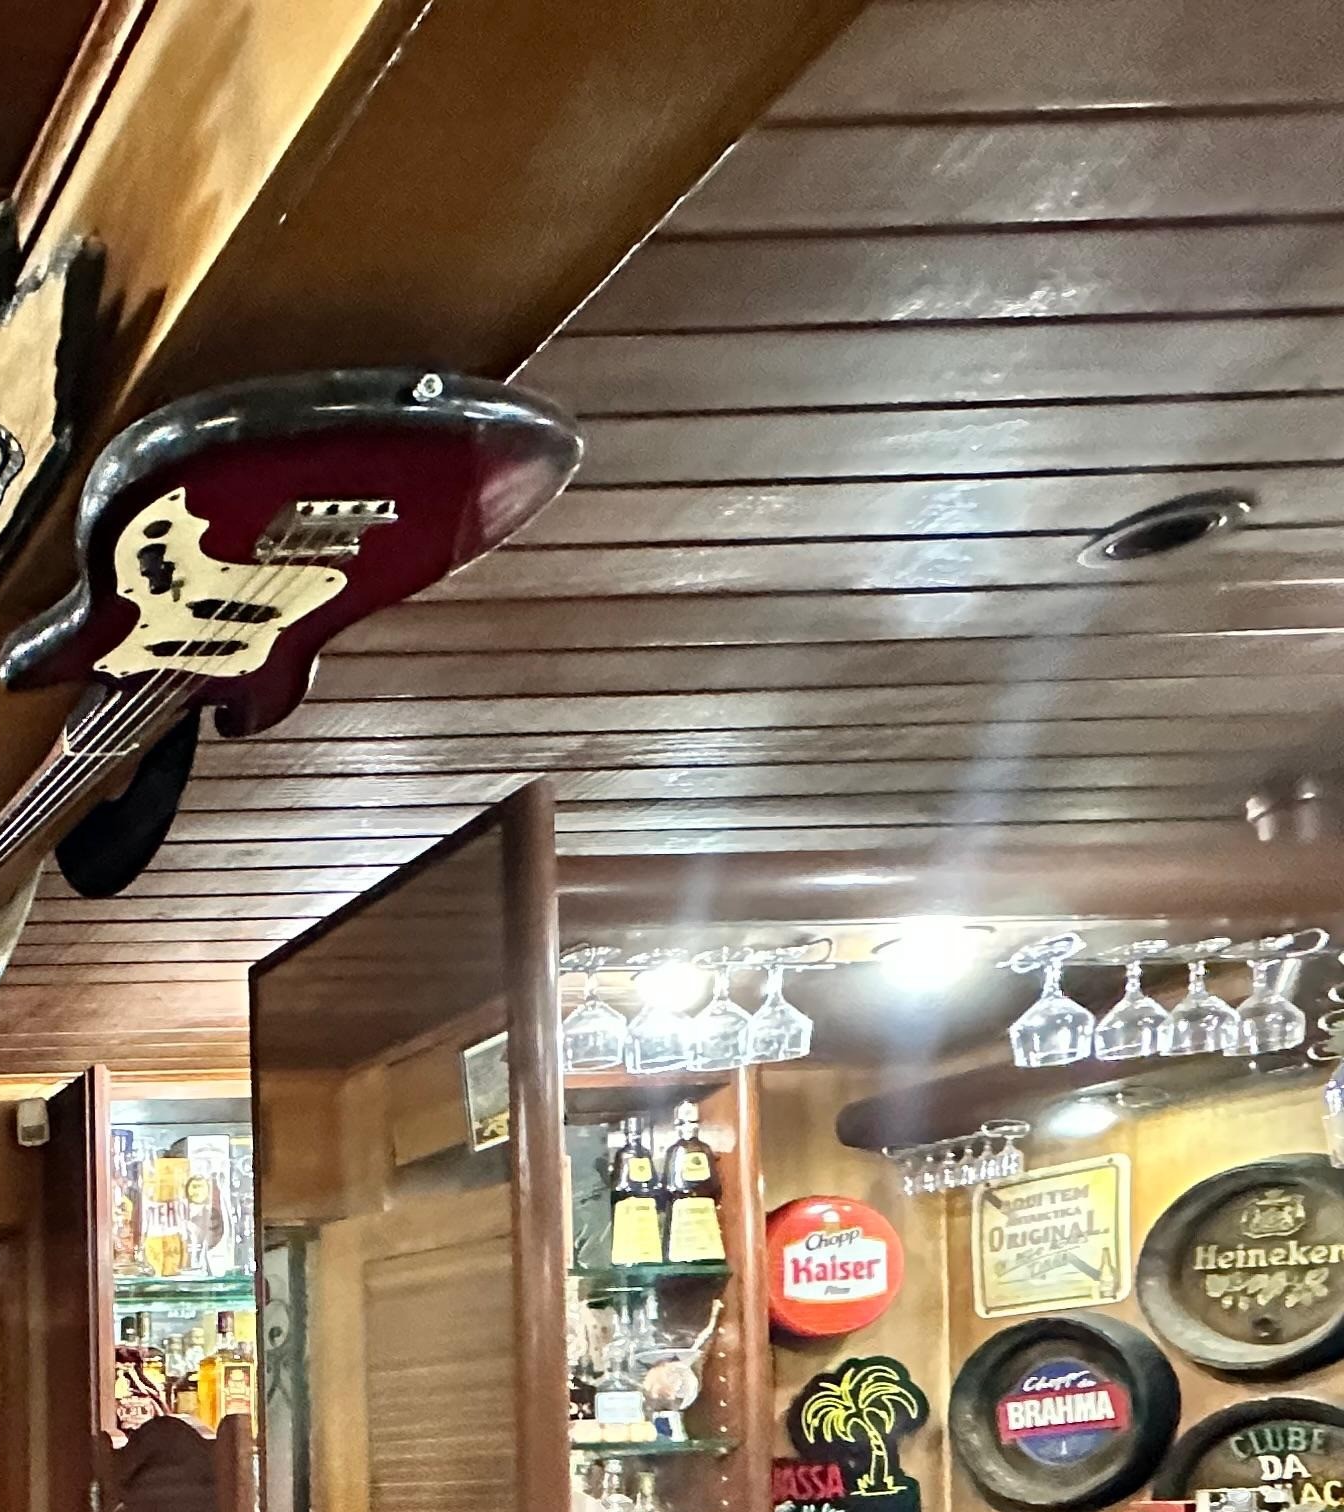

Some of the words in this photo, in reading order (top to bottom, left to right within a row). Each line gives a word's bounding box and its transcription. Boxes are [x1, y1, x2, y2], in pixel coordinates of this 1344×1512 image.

[1046, 1184, 1090, 1205] TEM
[805, 1230, 860, 1251] Chopp
[791, 1255, 881, 1284] Kaiser
[1006, 1391, 1116, 1430] BRAHMA
[1231, 1427, 1326, 1459] CLUBE
[1258, 1454, 1311, 1481] DA
